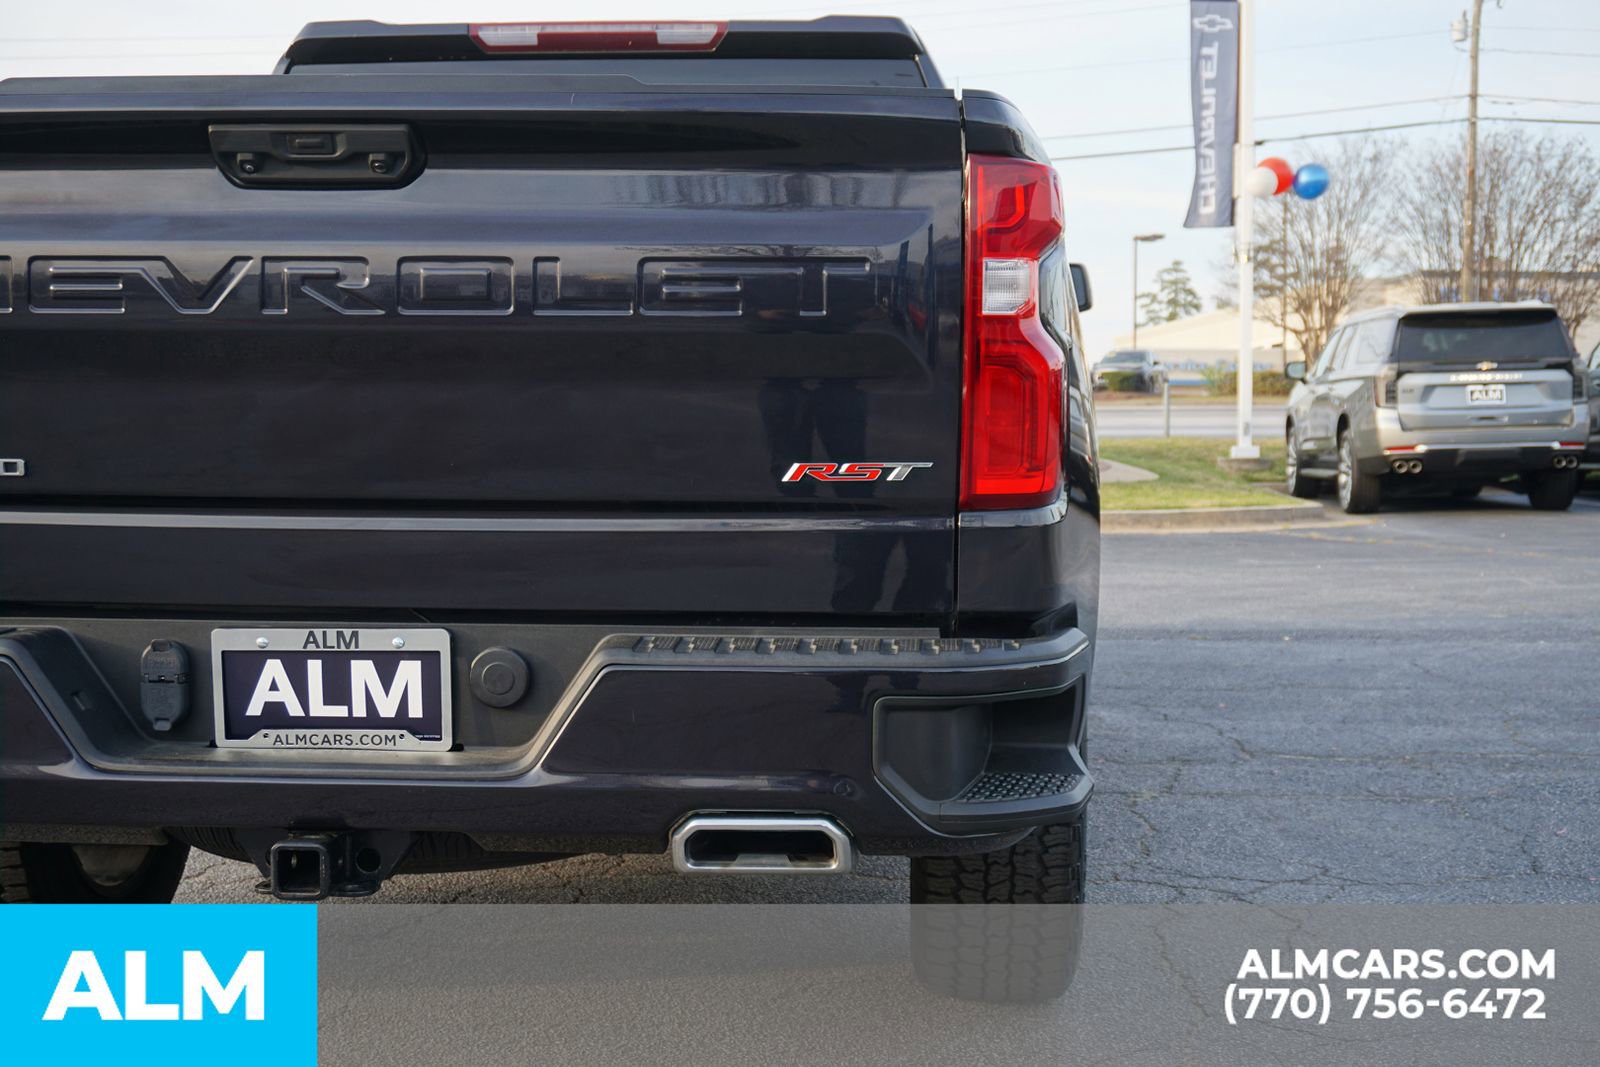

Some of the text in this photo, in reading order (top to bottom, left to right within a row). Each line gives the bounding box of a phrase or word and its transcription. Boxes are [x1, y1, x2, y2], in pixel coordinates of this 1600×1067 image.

[0, 255, 873, 316] EVROLET
[781, 462, 934, 482] RST
[303, 630, 359, 650] ALM
[245, 659, 423, 718] ALM
[273, 733, 397, 747] ALMCARS.COM
